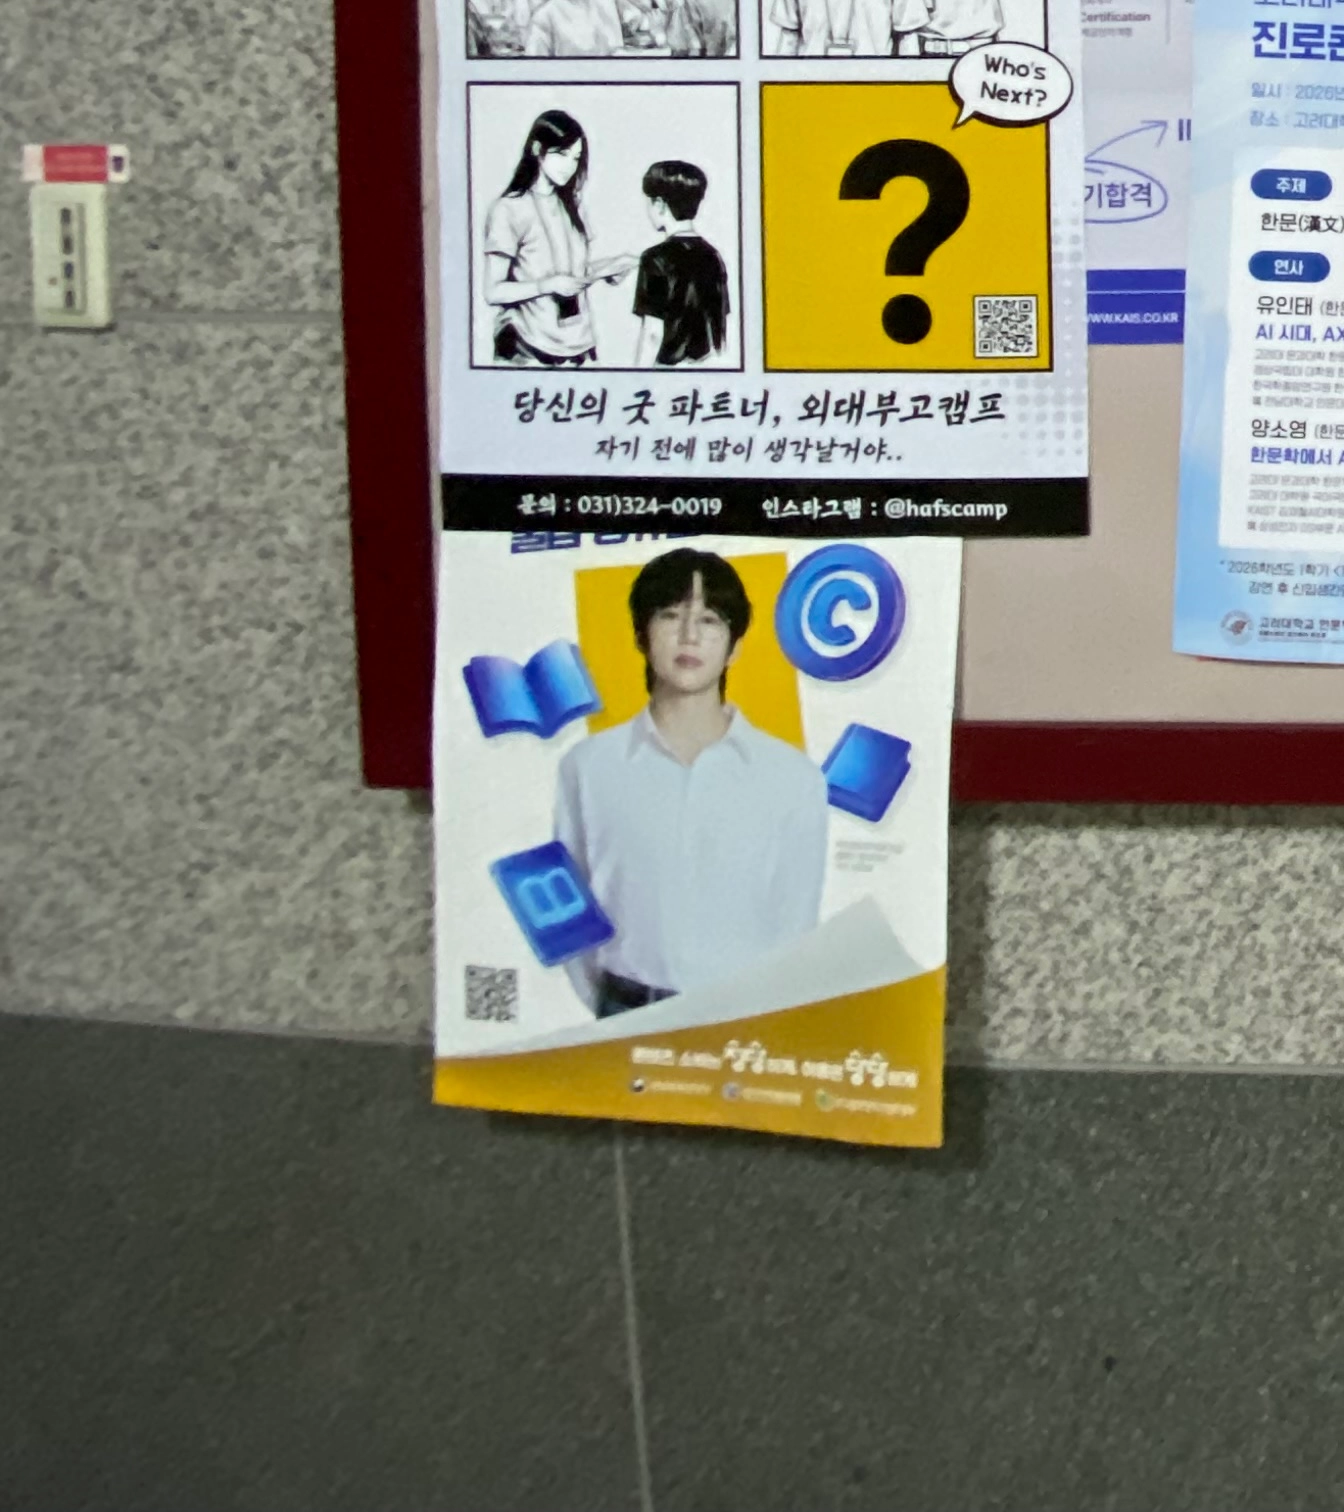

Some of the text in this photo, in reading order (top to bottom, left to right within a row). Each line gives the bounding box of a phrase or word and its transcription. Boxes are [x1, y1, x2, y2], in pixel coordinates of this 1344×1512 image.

[983, 54, 1047, 82] Who's
[980, 83, 1047, 108] Next?
[1276, 176, 1307, 195] 주제
[1274, 259, 1304, 276] 연사
[1256, 296, 1313, 316] 유인태
[1256, 324, 1273, 340] AI
[1279, 325, 1316, 344] 시대,
[514, 387, 1006, 429] 당신의 굿 파트너, 외대부고캠프
[1251, 419, 1308, 439] 양소영
[595, 436, 903, 463] 자기 전에 많이 생각날거야..
[1250, 446, 1332, 466] 한문학에서
[517, 495, 1008, 520] 문의 031)324-0019 인스타그램 @hafscamp
